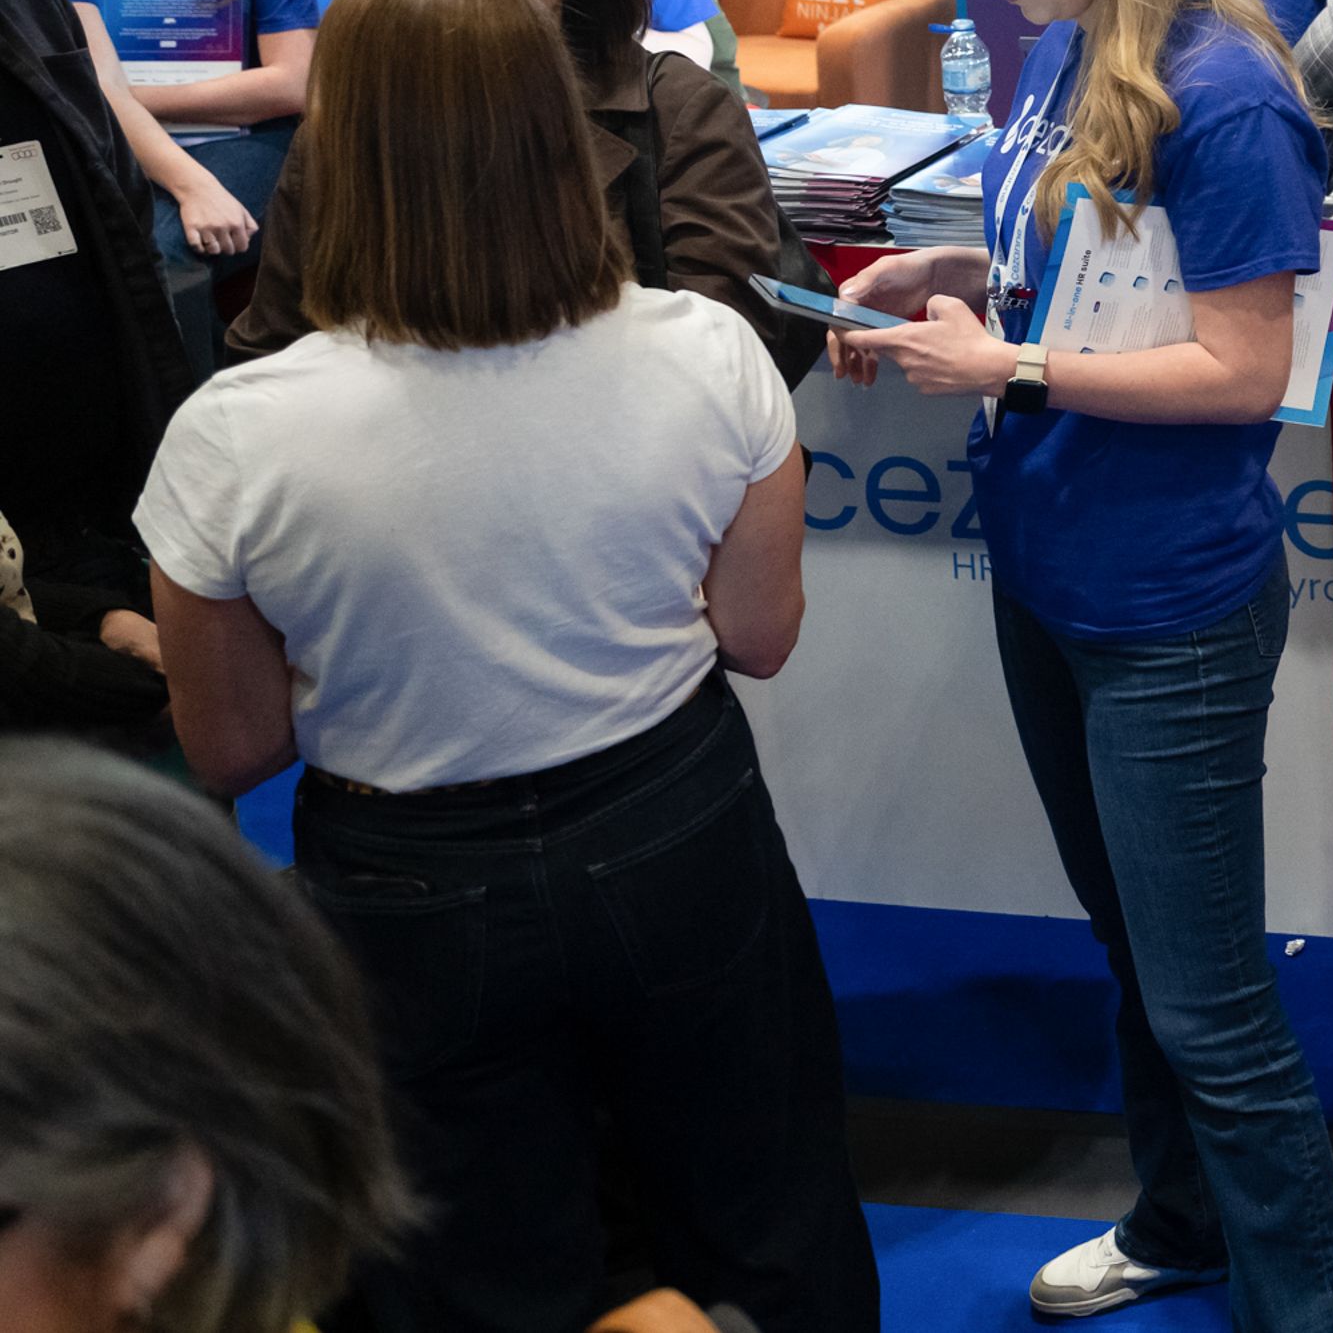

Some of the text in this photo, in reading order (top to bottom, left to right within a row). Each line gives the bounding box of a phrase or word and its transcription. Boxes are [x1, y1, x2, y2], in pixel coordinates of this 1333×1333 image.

[1010, 227, 1024, 282] cezanne
[1063, 248, 1093, 331] All-in-one HR suite
